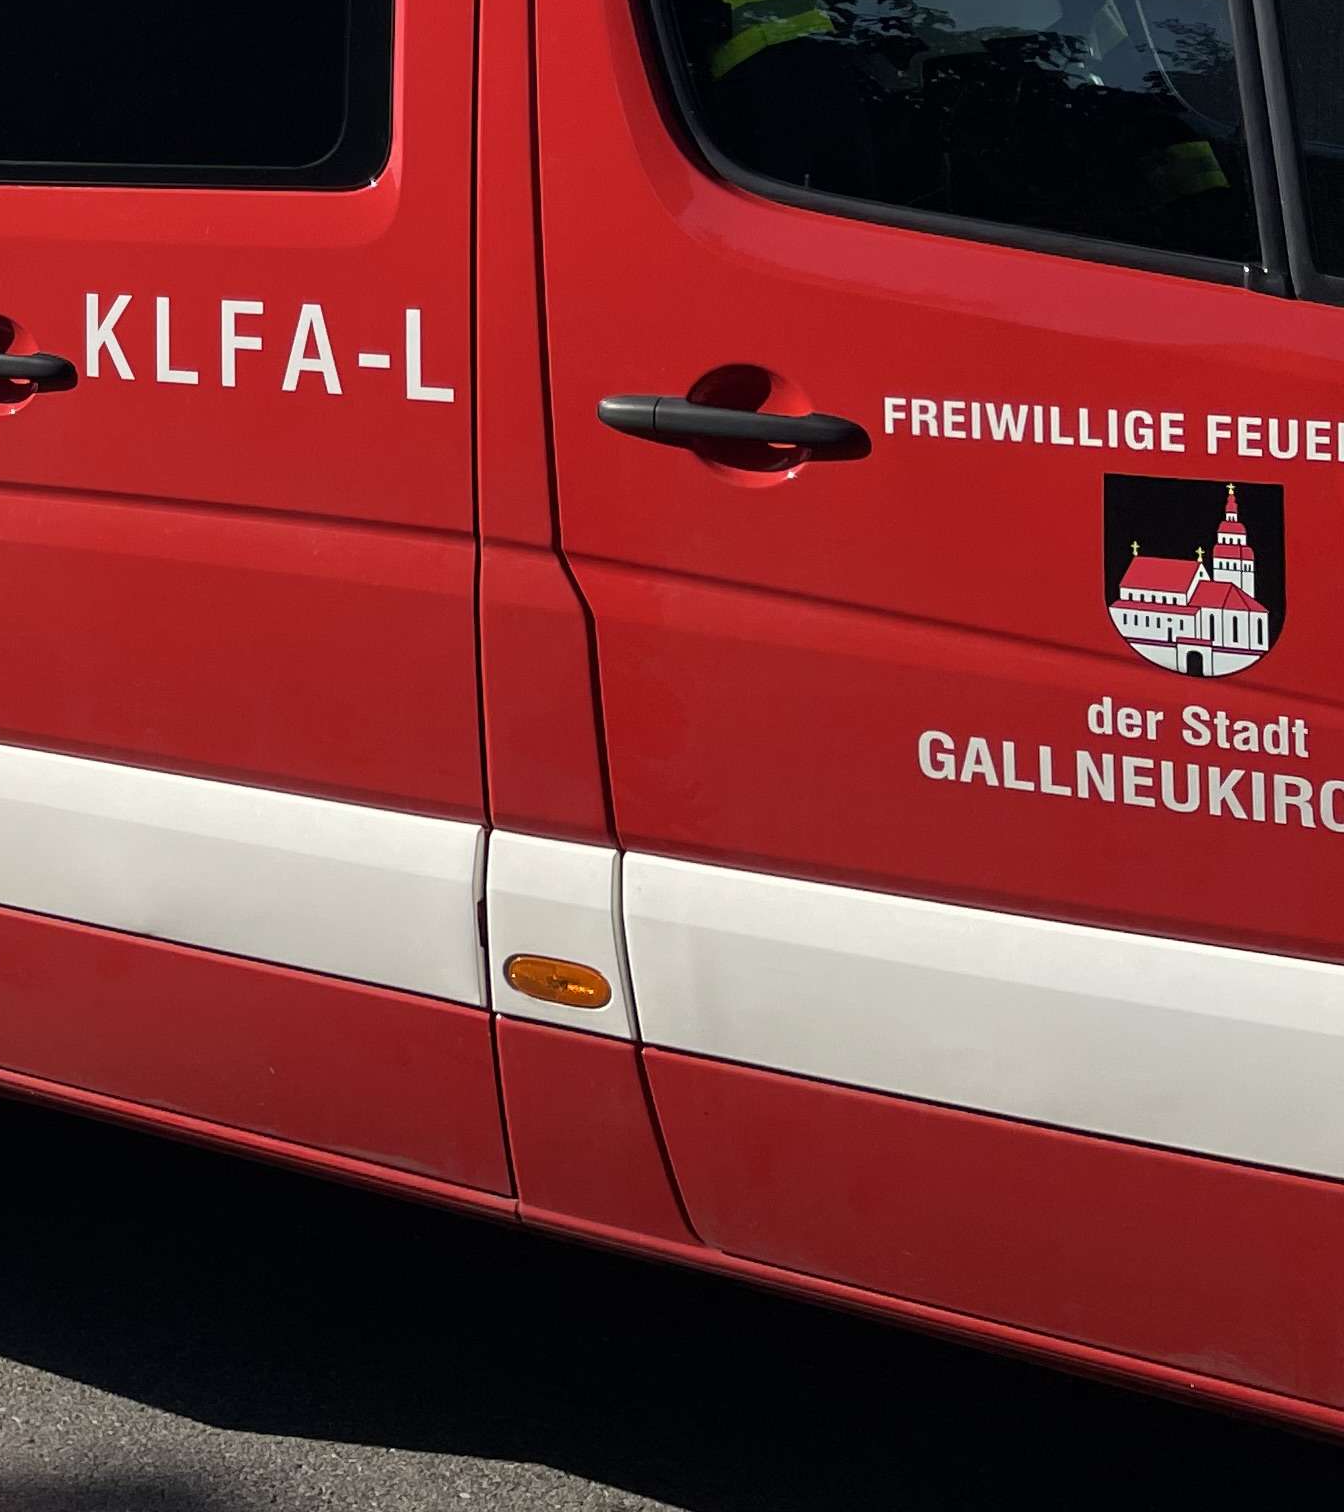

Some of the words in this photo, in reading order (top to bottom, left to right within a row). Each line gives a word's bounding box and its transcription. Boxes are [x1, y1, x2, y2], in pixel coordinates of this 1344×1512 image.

[85, 292, 455, 403] KLFA-L
[883, 396, 1186, 453] FREIWILLIGE
[1087, 696, 1164, 740] der
[1181, 705, 1310, 758] Stadt
[918, 730, 1344, 834] GALLNEUKIRC
